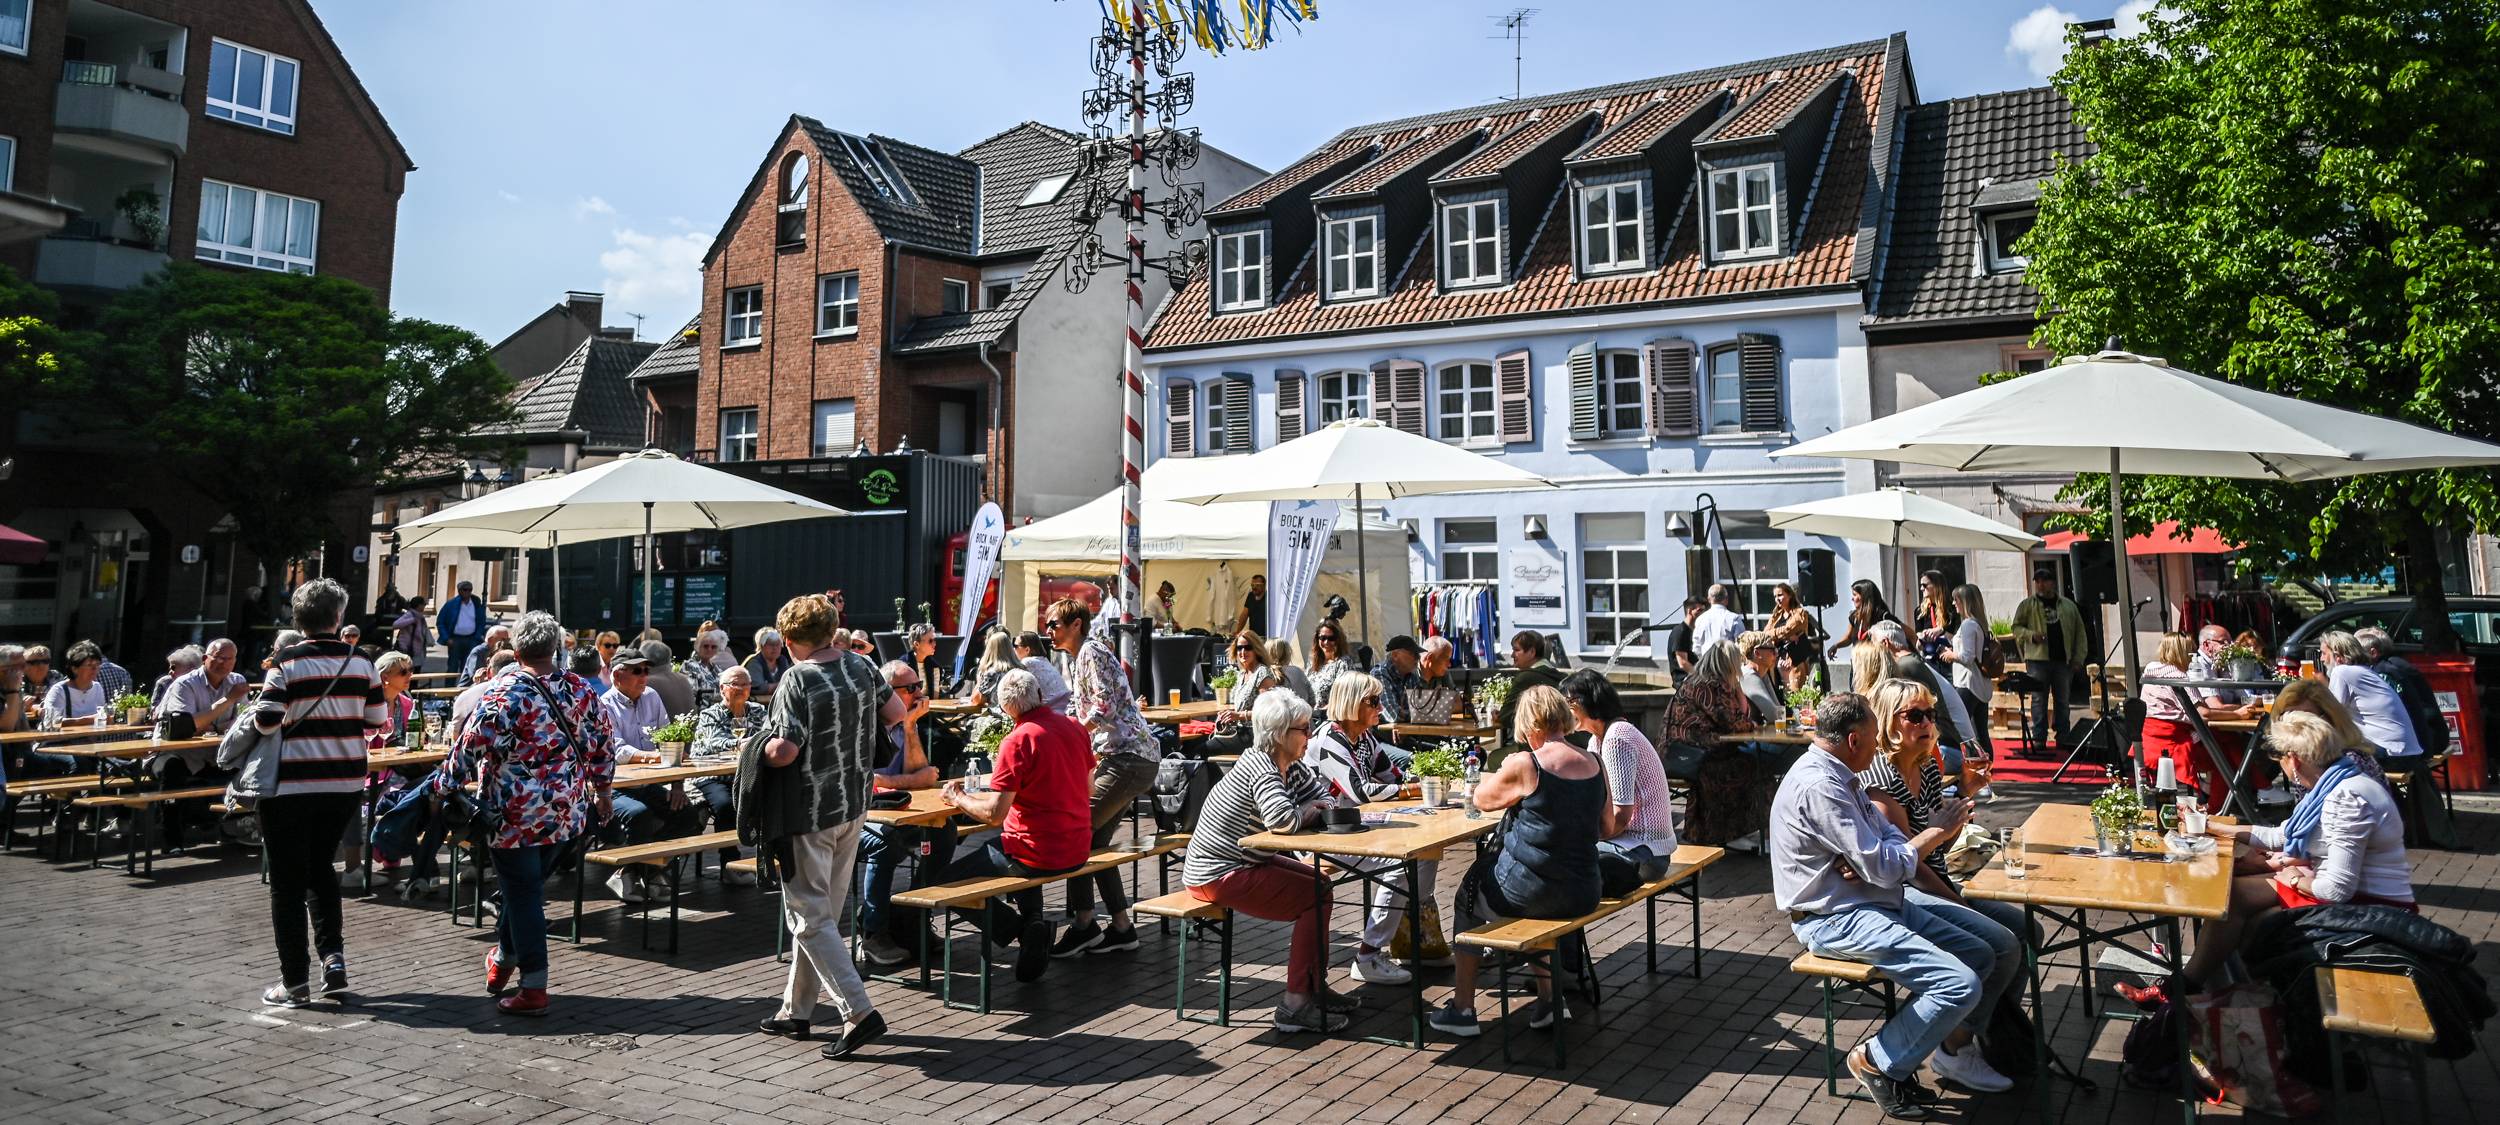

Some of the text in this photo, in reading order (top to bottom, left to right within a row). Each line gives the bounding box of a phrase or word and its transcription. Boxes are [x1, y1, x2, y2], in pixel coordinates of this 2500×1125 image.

[1280, 514, 1329, 532] BOCK AUF
[1288, 530, 1312, 550] GIN
[1329, 534, 1342, 551] GIN
